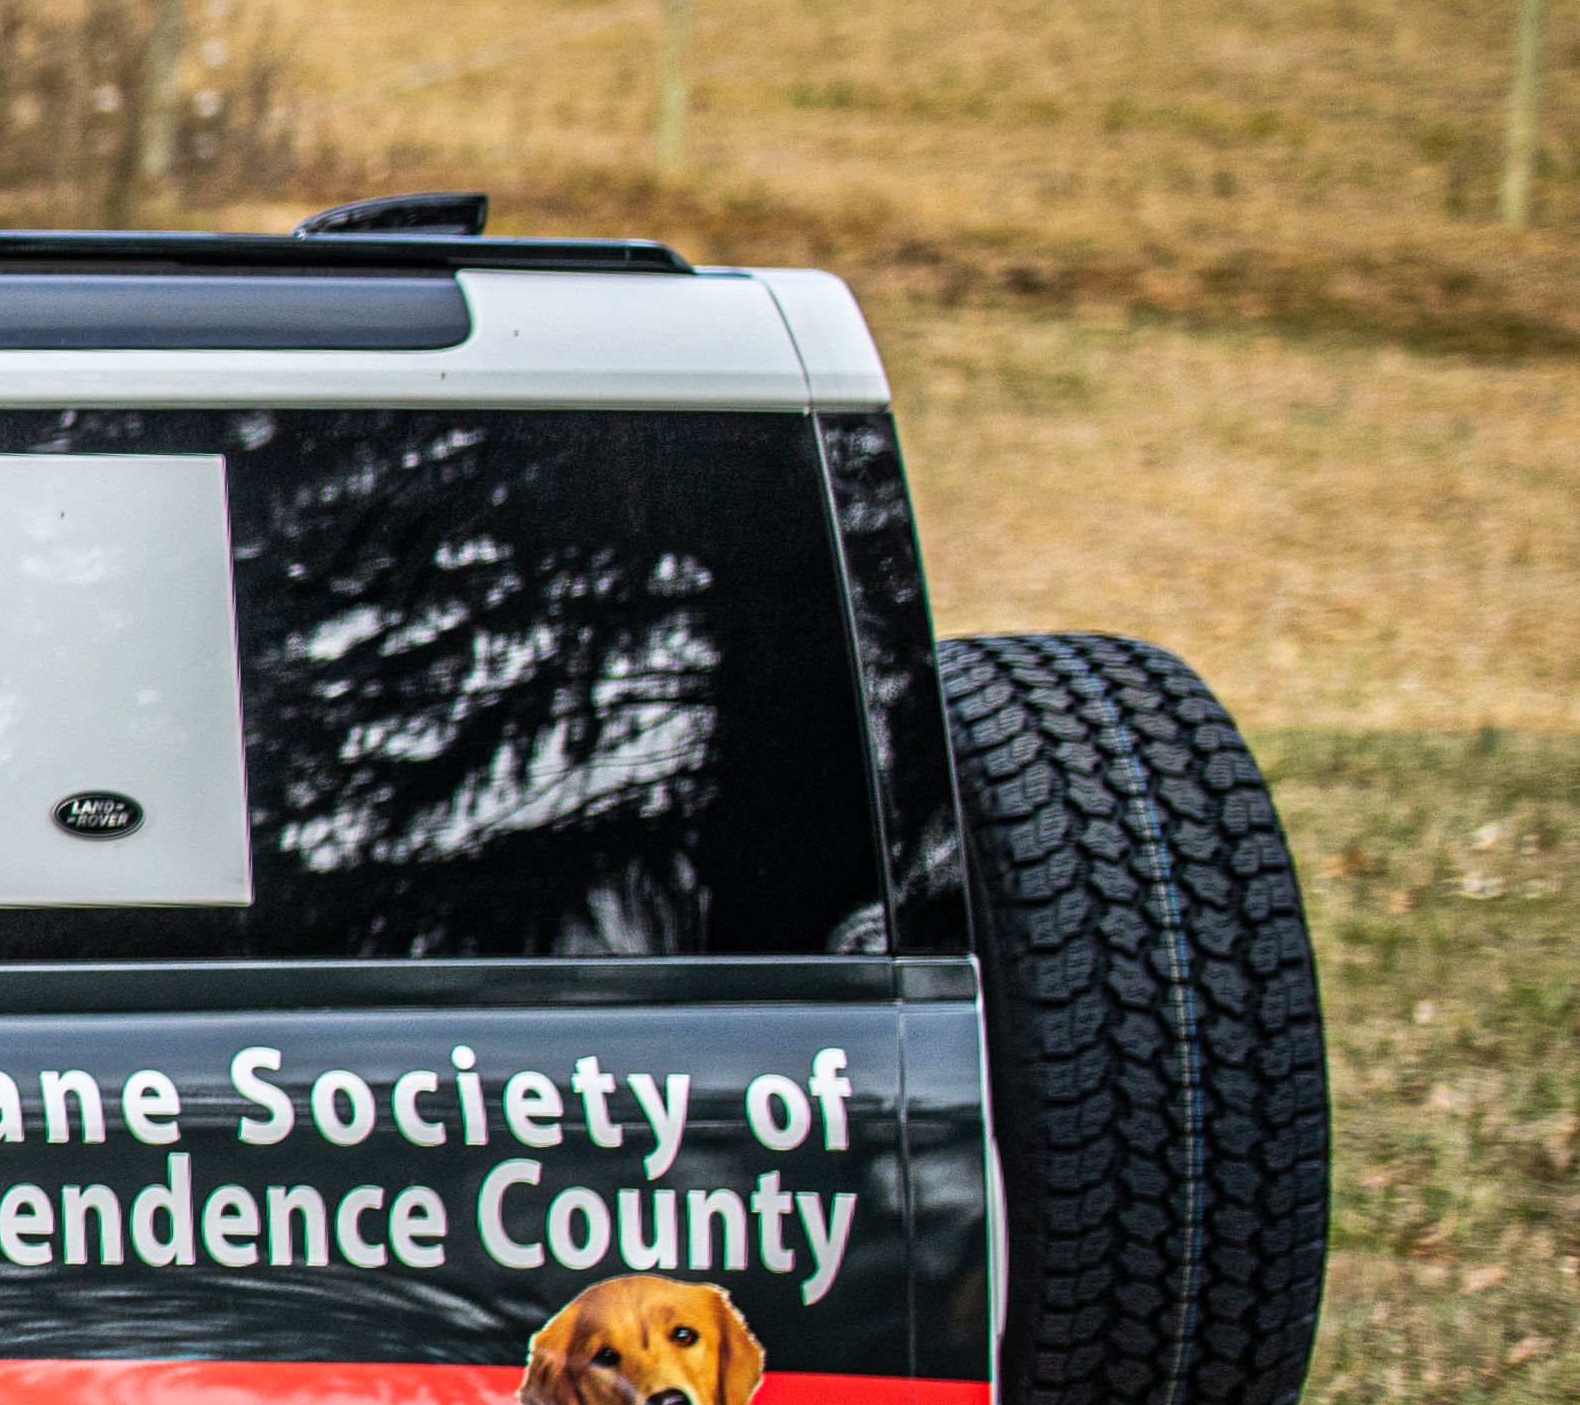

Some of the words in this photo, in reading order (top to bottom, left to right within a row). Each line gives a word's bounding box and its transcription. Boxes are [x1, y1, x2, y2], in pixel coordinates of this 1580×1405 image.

[227, 1046, 691, 1182] Society
[745, 1048, 853, 1152] of
[475, 1158, 858, 1307] County
